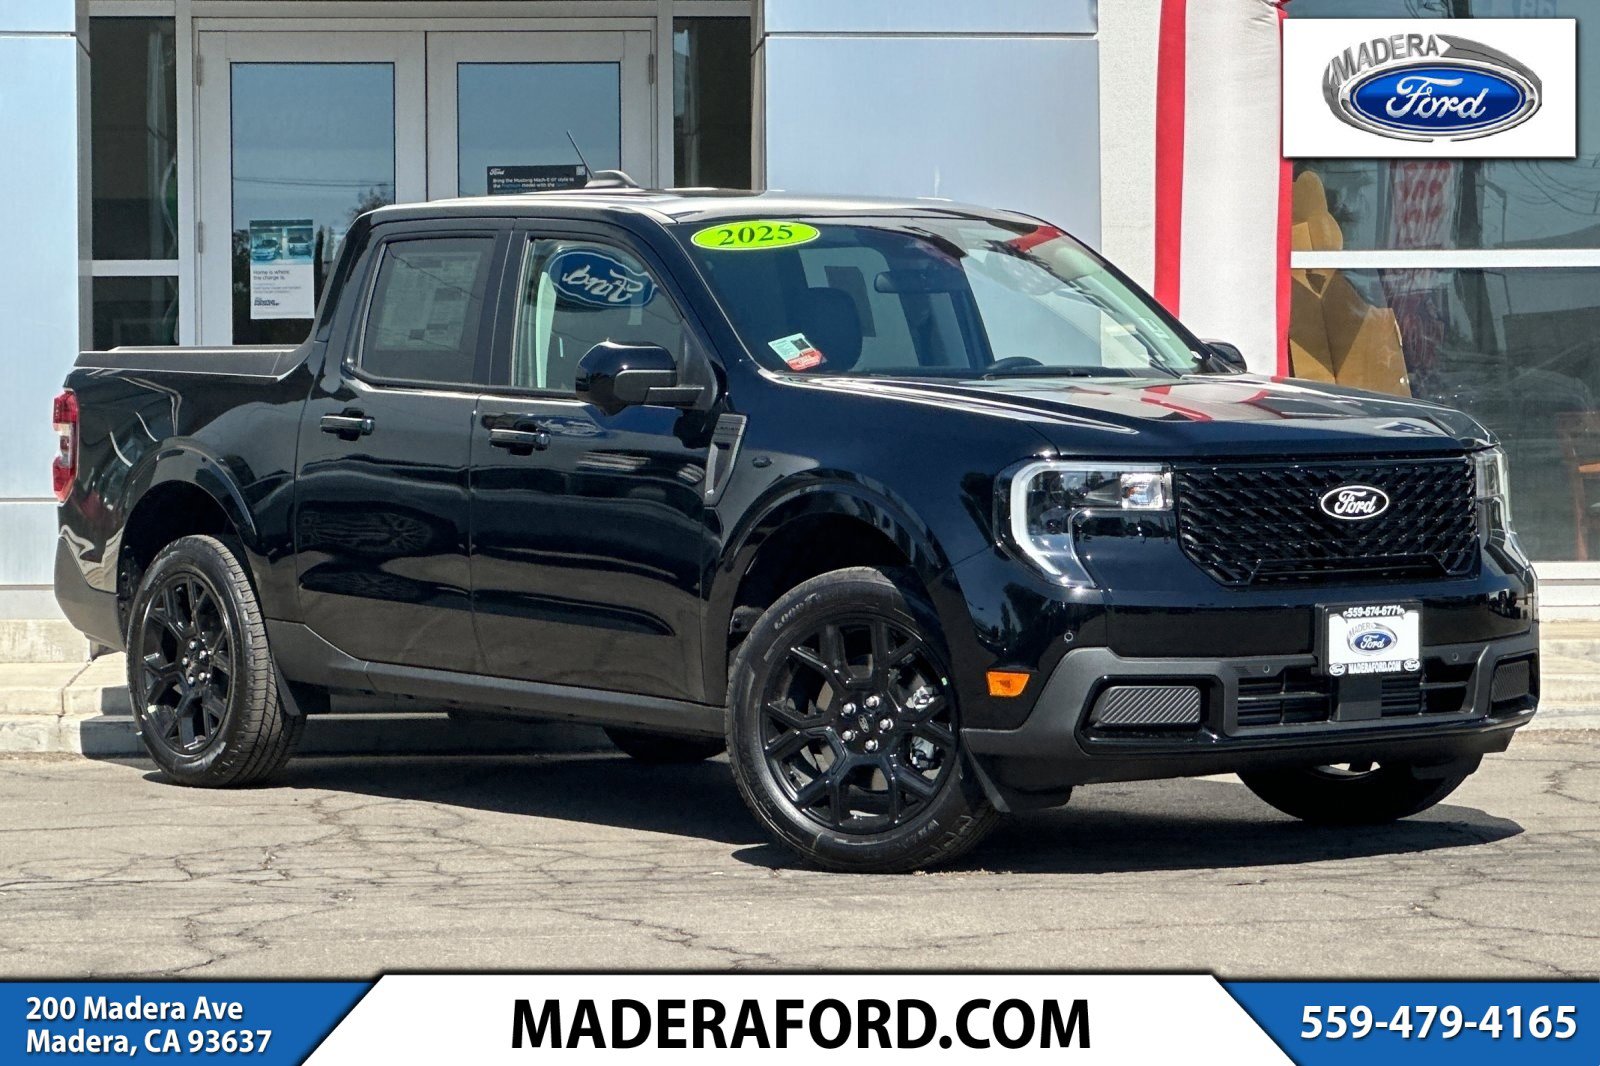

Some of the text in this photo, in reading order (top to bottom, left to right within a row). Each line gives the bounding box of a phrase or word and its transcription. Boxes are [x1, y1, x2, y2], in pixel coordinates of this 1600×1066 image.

[718, 225, 793, 246] 2025
[1334, 490, 1377, 514] Ford
[1361, 634, 1385, 649] Ford
[1348, 660, 1402, 674] MADERAFORD.COM
